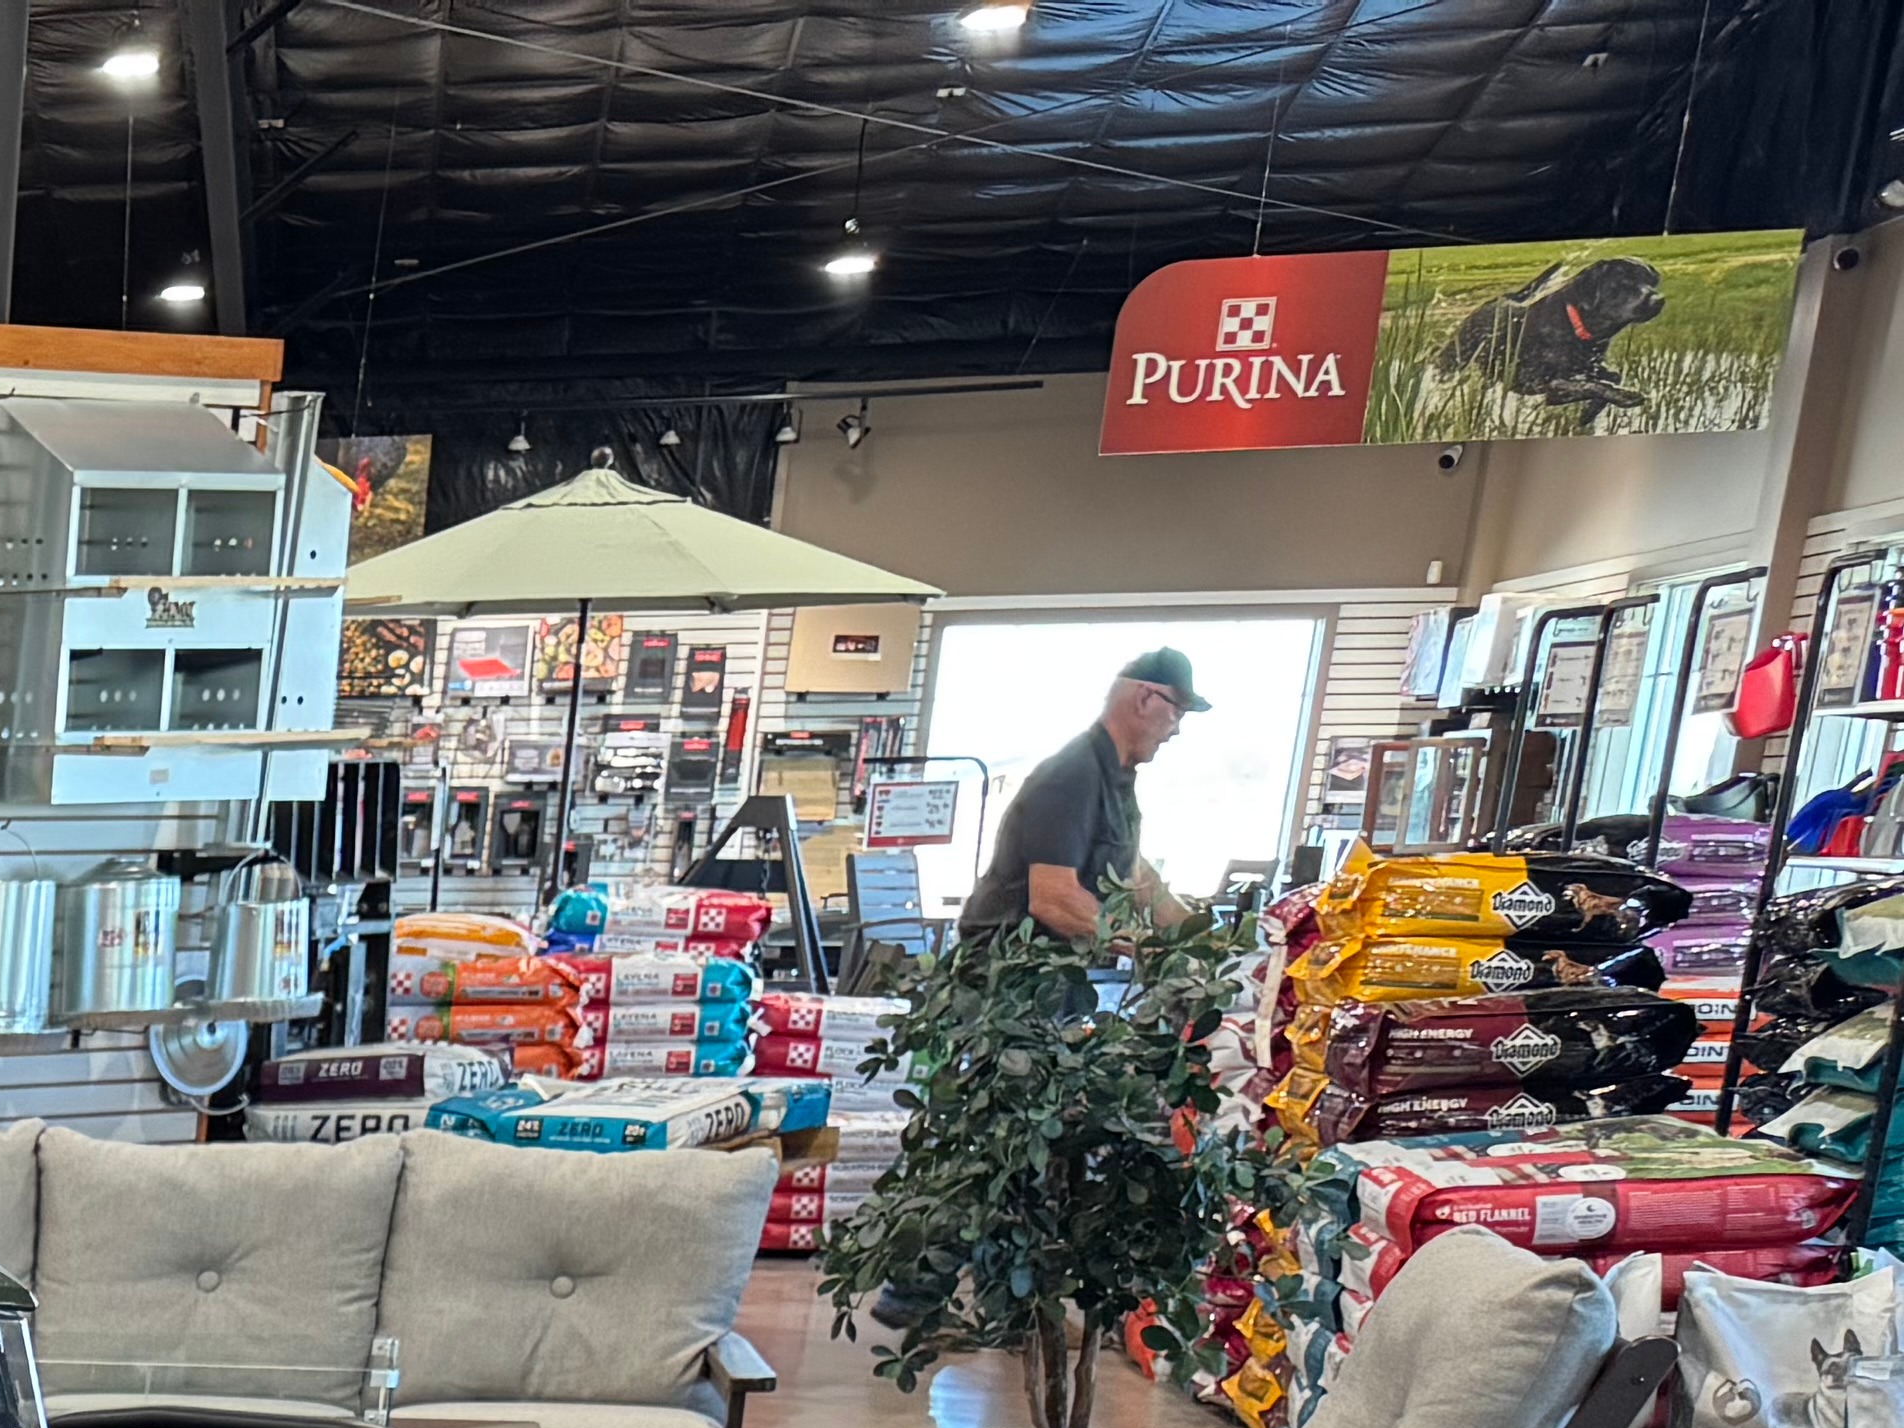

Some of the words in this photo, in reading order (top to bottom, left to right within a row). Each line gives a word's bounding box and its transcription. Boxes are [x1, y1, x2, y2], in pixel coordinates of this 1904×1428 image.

[1126, 352, 1346, 409] PURINA
[1492, 891, 1553, 912] Diamond
[1470, 959, 1532, 980] Diamond
[1420, 1028, 1474, 1039] ENERGY
[1493, 1037, 1559, 1060] Diamond
[318, 1061, 363, 1078] ZERO
[1413, 1098, 1468, 1111] ENERGY
[310, 1115, 409, 1142] ZERO
[558, 1122, 604, 1137] ZERO
[704, 1102, 746, 1141] ZERO
